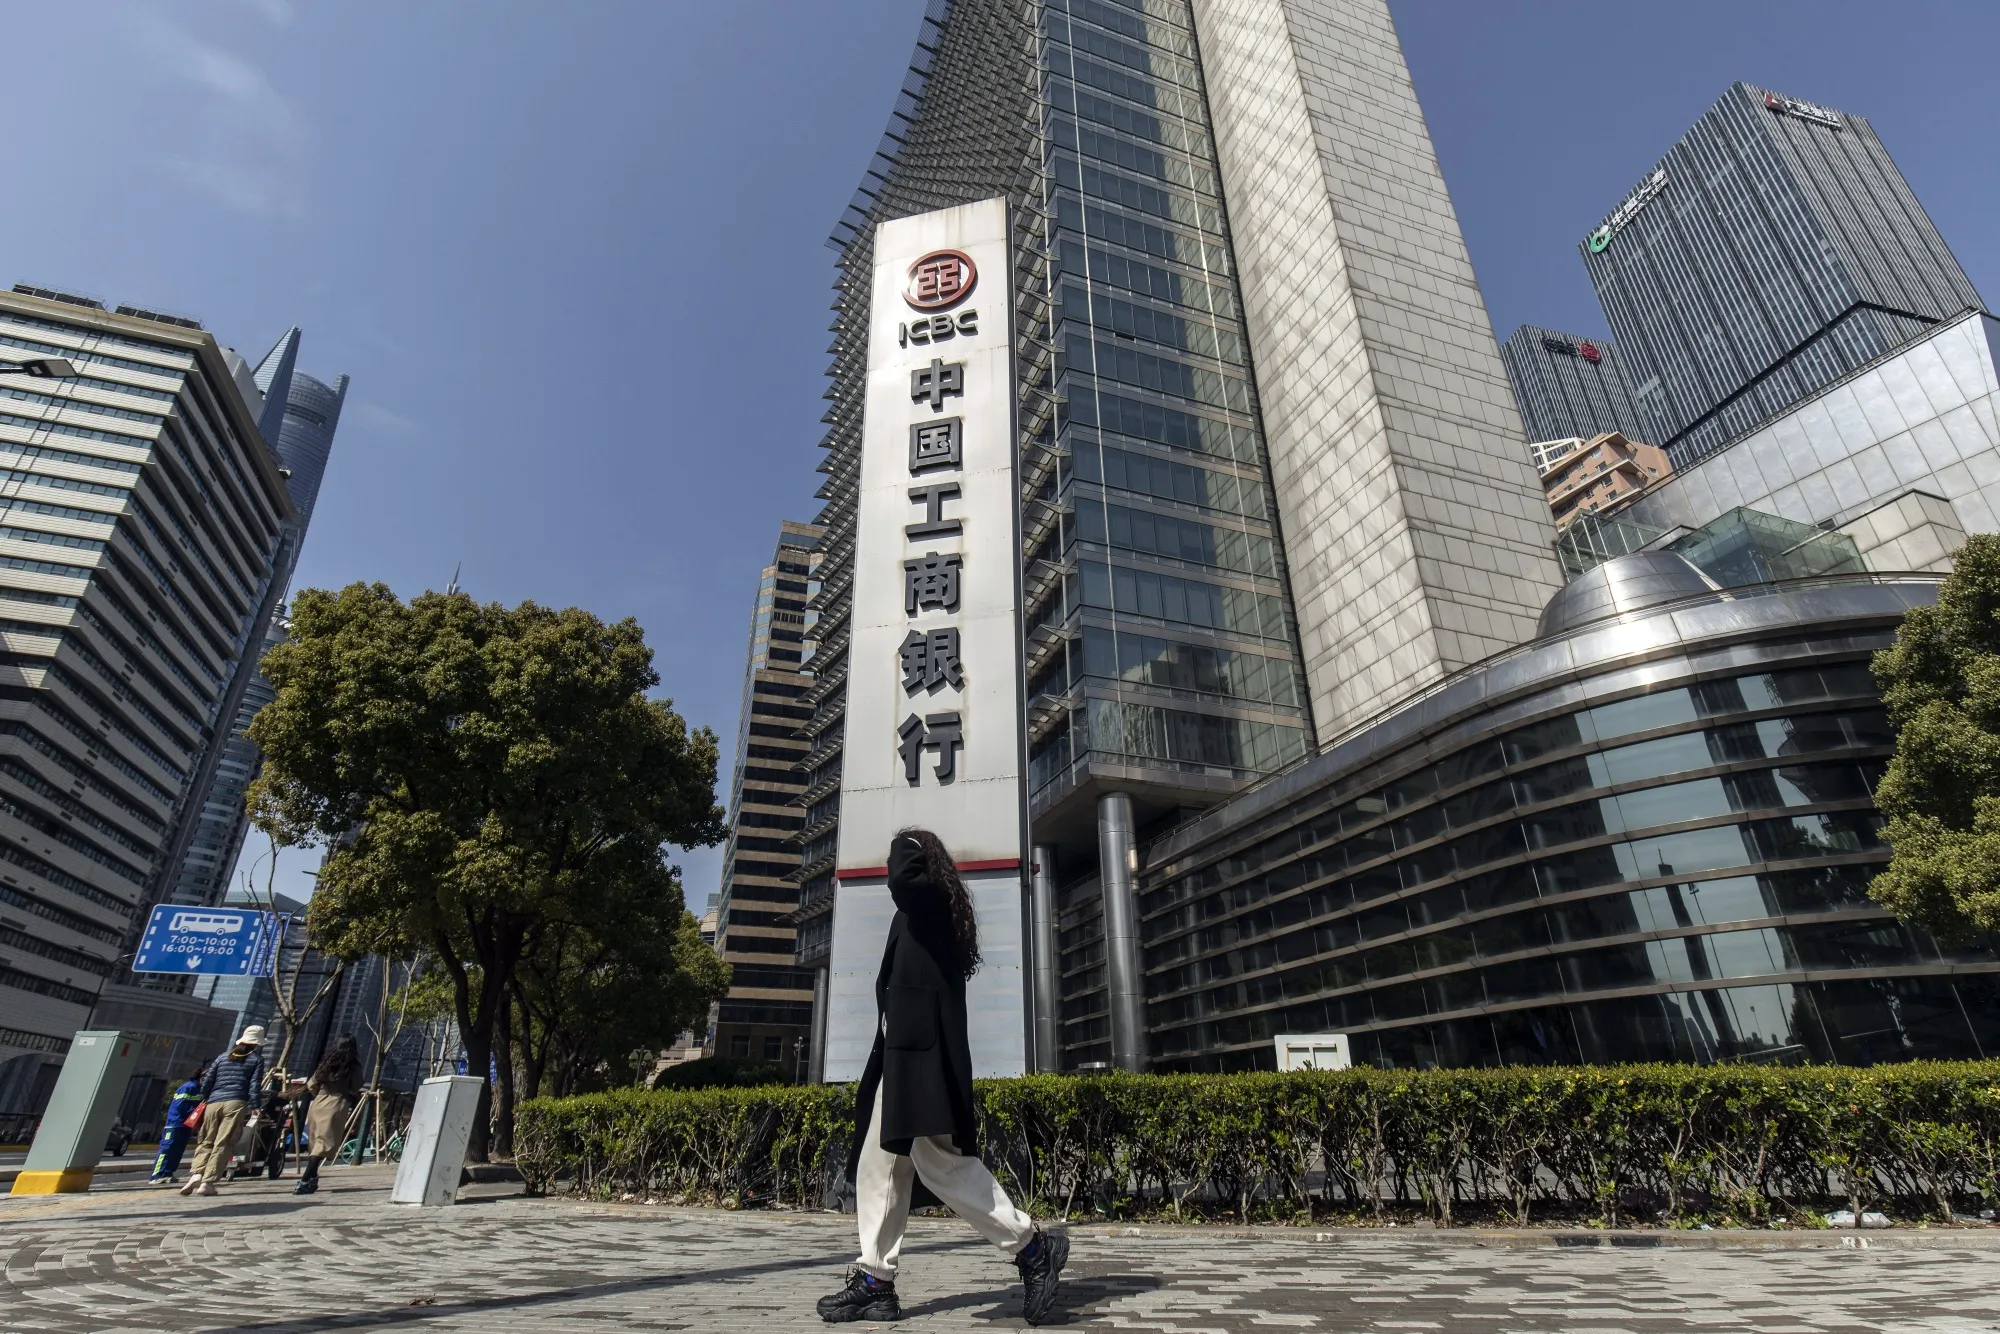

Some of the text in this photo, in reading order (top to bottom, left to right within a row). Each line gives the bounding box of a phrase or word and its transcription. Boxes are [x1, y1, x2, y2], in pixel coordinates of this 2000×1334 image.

[1612, 168, 1666, 226] 中国人寿
[1615, 176, 1670, 232] CHINA LIFE
[898, 308, 978, 347] ICBC
[897, 357, 966, 786] 中国工商银行
[161, 944, 234, 956] 16:00~19:00
[170, 935, 237, 947] 7:00~10:00
